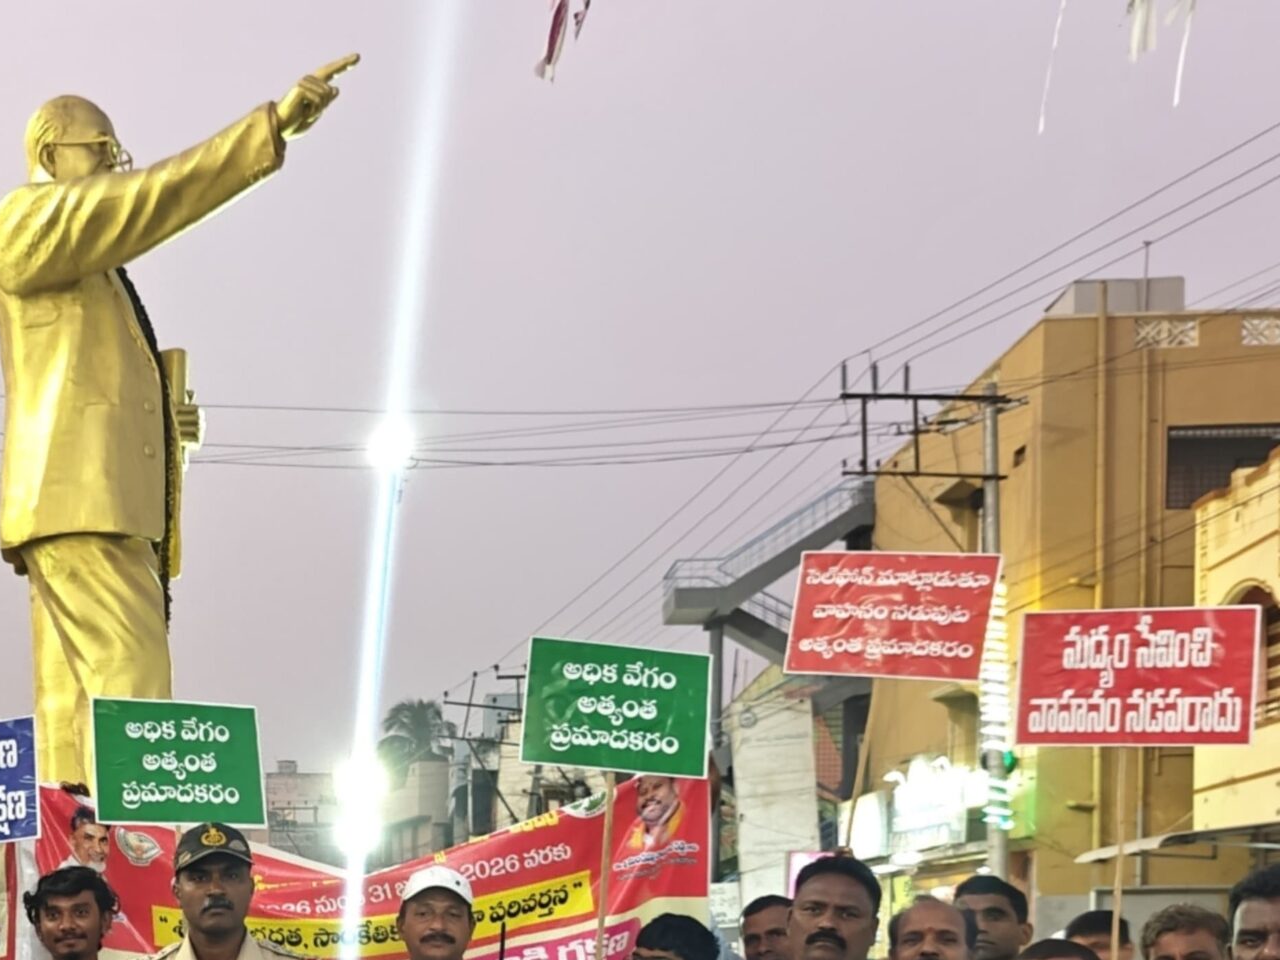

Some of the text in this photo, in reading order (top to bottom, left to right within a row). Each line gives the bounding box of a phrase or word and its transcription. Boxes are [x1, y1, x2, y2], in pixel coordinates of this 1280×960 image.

[812, 602, 888, 622] వాహనం
[798, 635, 975, 661] అత్యంత ప్రమాదకరం
[1062, 613, 1215, 690] మద్యం సేవించి
[562, 661, 678, 690] అధిక వేగం
[576, 694, 658, 727] అత్యంత
[1027, 686, 1243, 735] వాహనం నడపరాదు
[124, 716, 231, 745] అధిక వేగం
[549, 721, 680, 756] ప్రమాదకరం
[141, 750, 218, 781] అత్యంత
[120, 780, 241, 811] ప్రమాదకరం
[460, 853, 521, 882] 2026
[368, 882, 394, 904] 31
